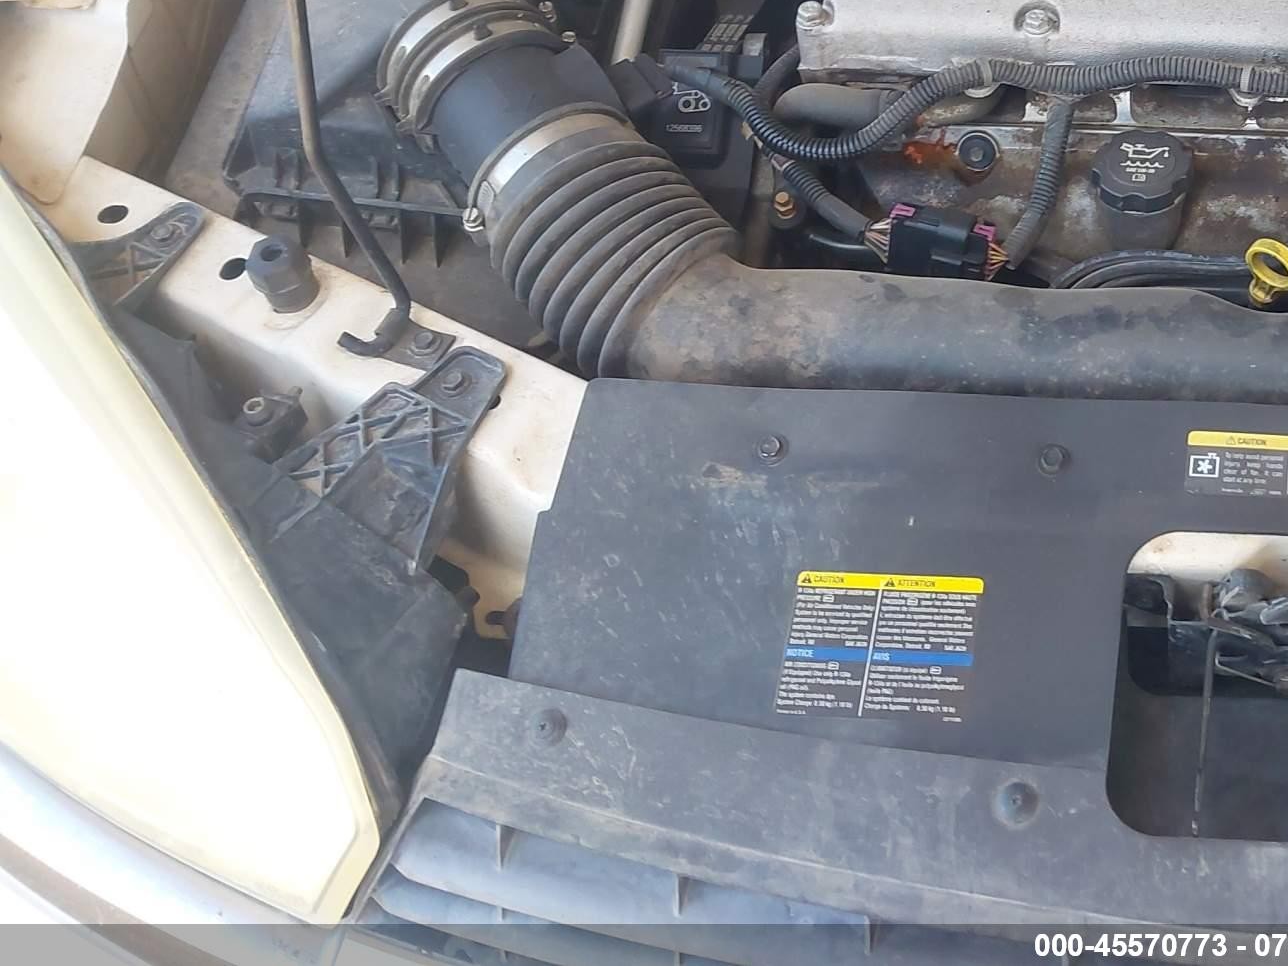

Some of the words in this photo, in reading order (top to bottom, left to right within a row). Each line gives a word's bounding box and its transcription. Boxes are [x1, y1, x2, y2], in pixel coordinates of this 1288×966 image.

[1237, 437, 1266, 446] CAUTION
[814, 575, 844, 583] CAUTION
[898, 579, 936, 587] ATTENTION
[786, 649, 814, 657] NOTICE
[873, 652, 890, 661] AVIS
